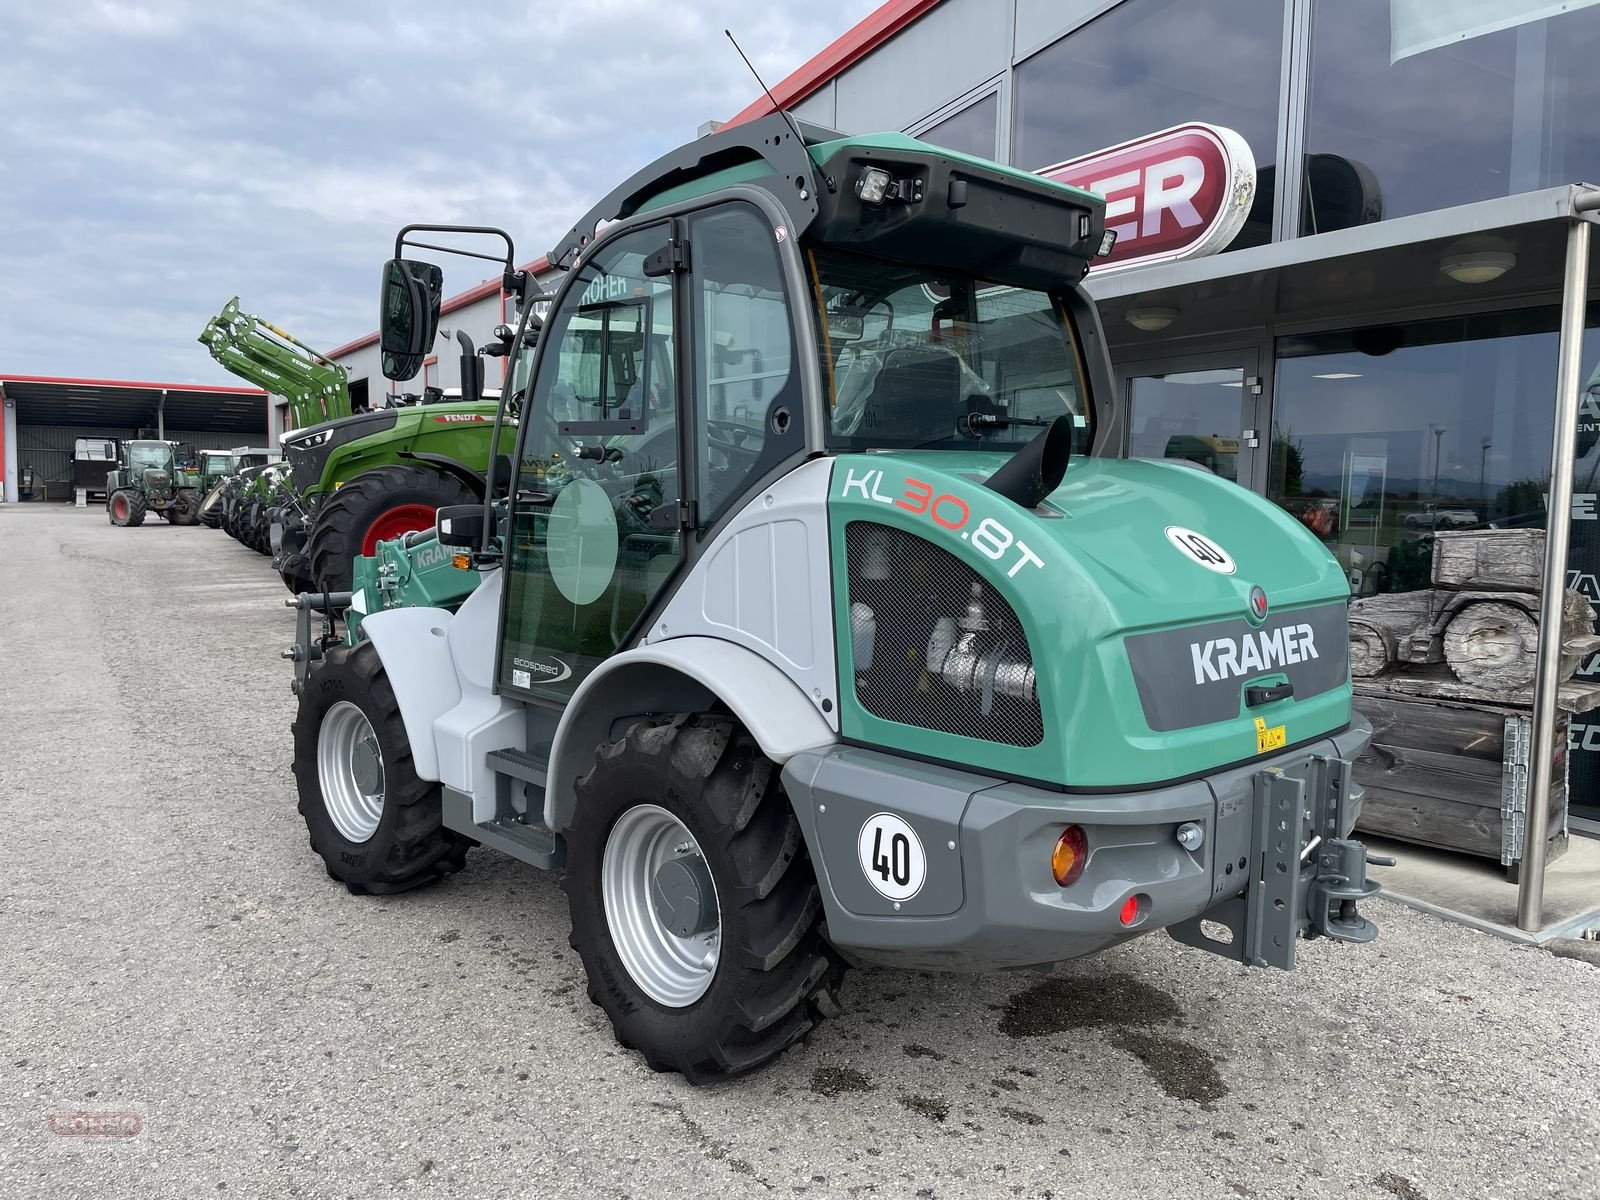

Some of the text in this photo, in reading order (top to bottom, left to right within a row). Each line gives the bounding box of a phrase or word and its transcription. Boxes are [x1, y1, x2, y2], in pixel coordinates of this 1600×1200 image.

[1078, 156, 1205, 244] ER
[261, 368, 281, 380] FENDT
[291, 358, 313, 371] FENDT
[444, 414, 477, 422] FENDT
[842, 468, 1045, 578] KL30.8T
[1174, 534, 1226, 565] 40
[513, 656, 559, 676] ecospeed
[1190, 623, 1319, 685] KRAMER
[871, 827, 911, 887] 40
